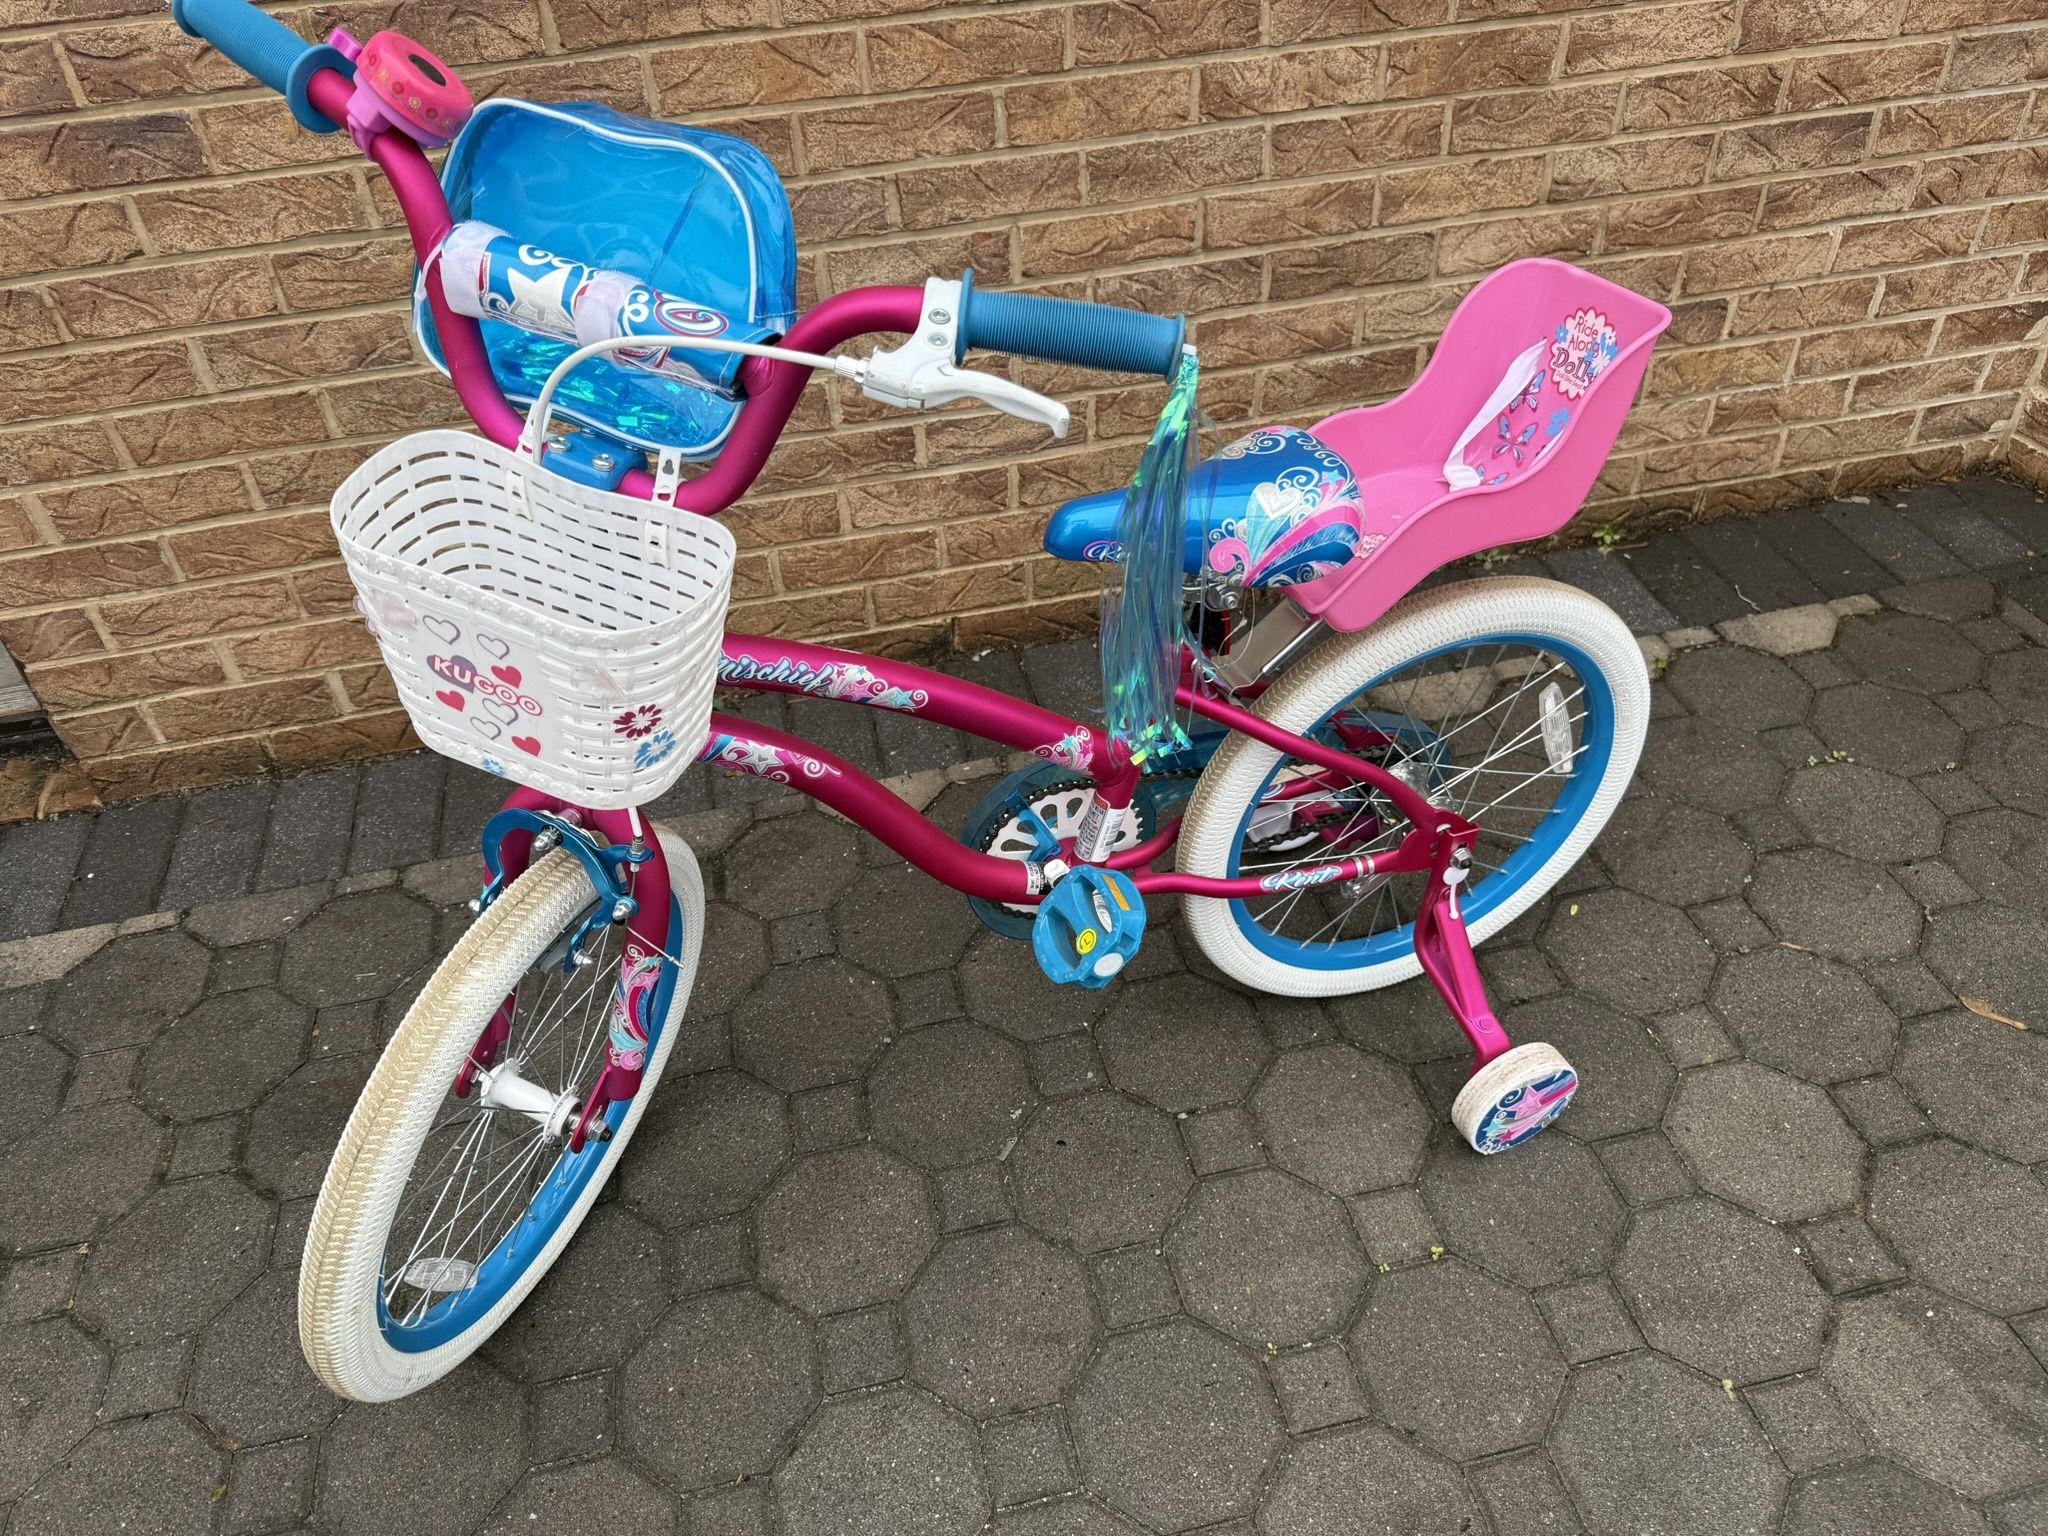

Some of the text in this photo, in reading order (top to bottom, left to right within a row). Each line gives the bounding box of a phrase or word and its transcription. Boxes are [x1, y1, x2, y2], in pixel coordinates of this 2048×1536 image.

[1574, 315, 1599, 340] Ride
[1567, 333, 1600, 359] Along
[432, 654, 543, 717] KUGOO
